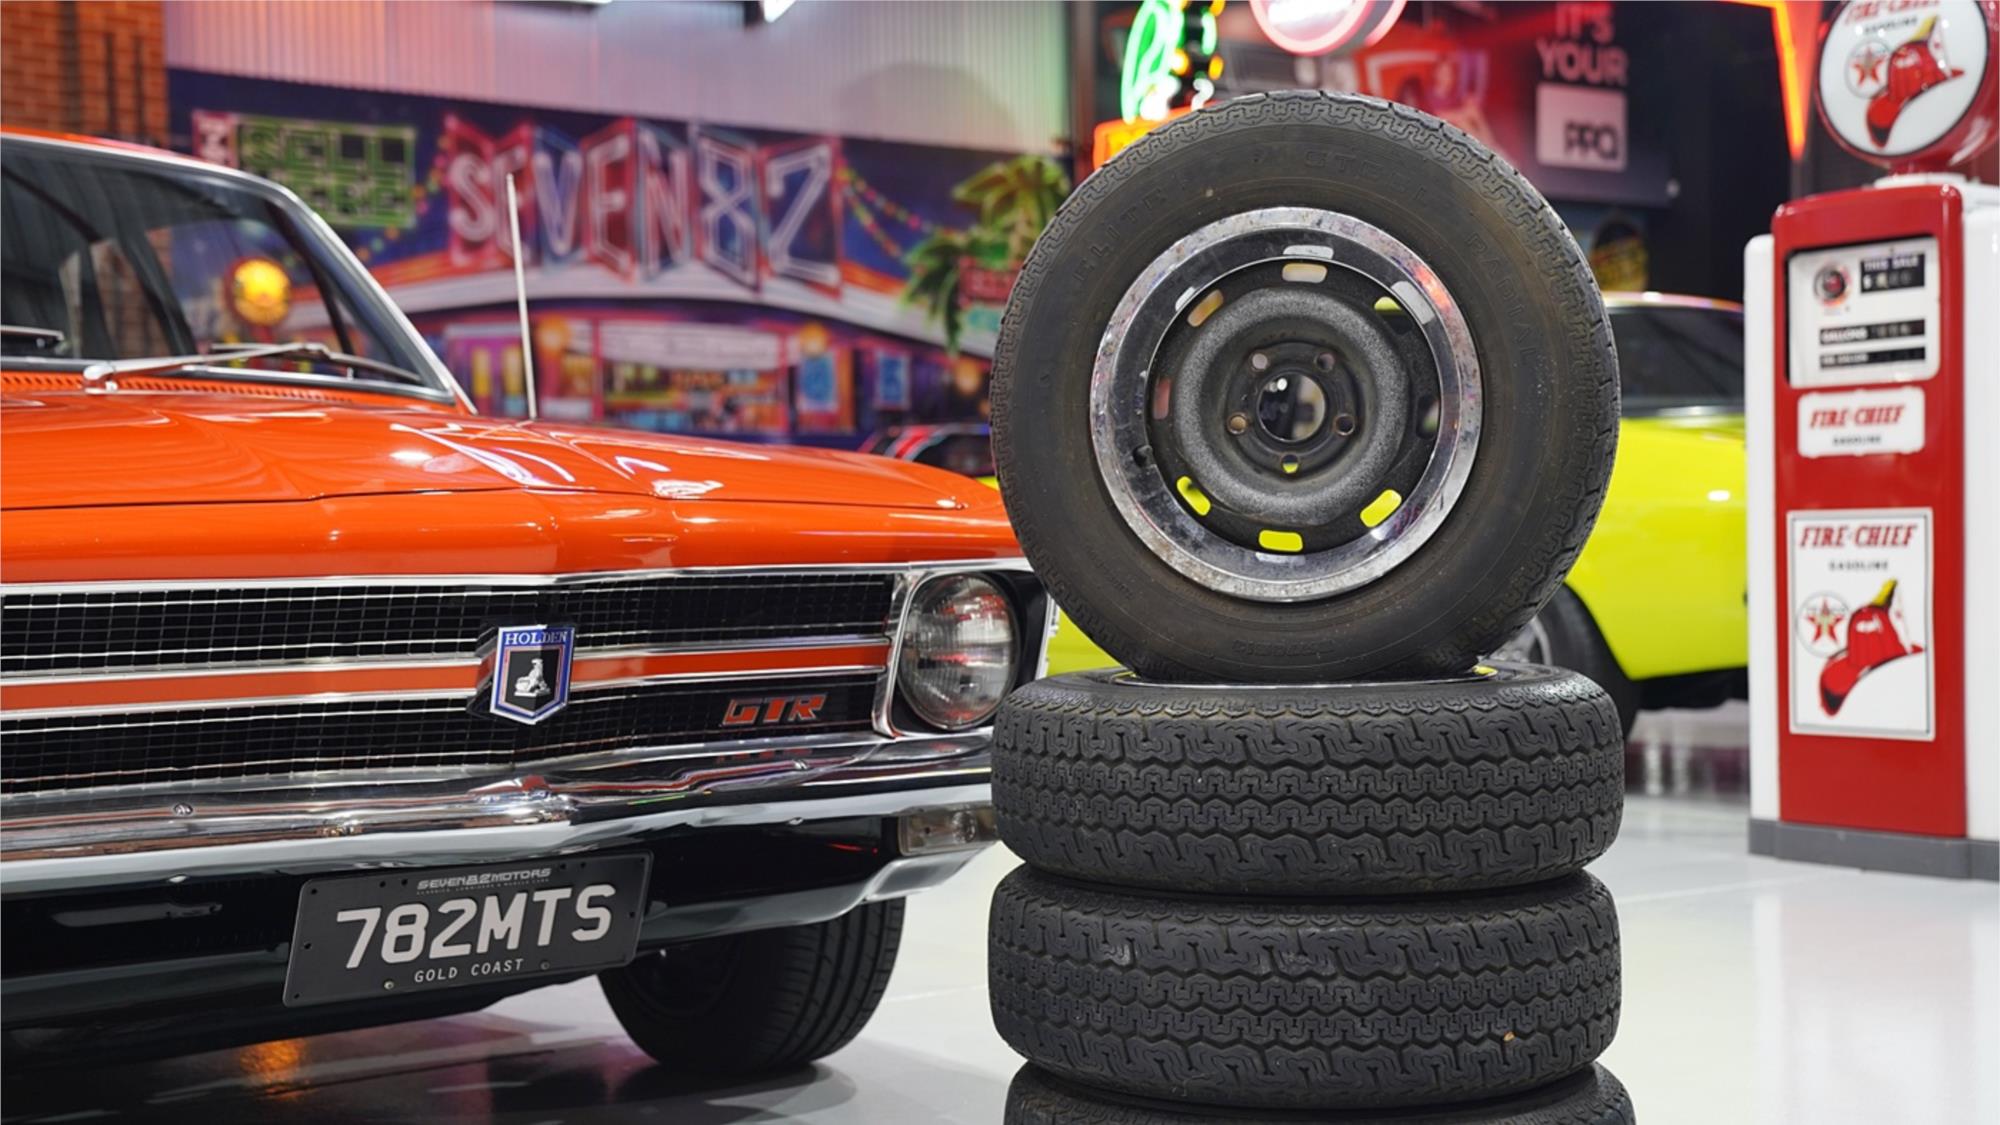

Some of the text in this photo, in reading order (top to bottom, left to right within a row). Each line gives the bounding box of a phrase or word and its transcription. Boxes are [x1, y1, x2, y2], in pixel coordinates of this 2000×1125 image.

[1536, 38, 1630, 85] YOUR
[1467, 232, 1538, 366] RADIAL
[1829, 560, 1889, 571] GASOLINE
[504, 630, 568, 645] HOLDEN
[720, 692, 828, 725] GTR
[336, 884, 616, 969] 782MTS
[414, 958, 524, 983] GOLD COAST
